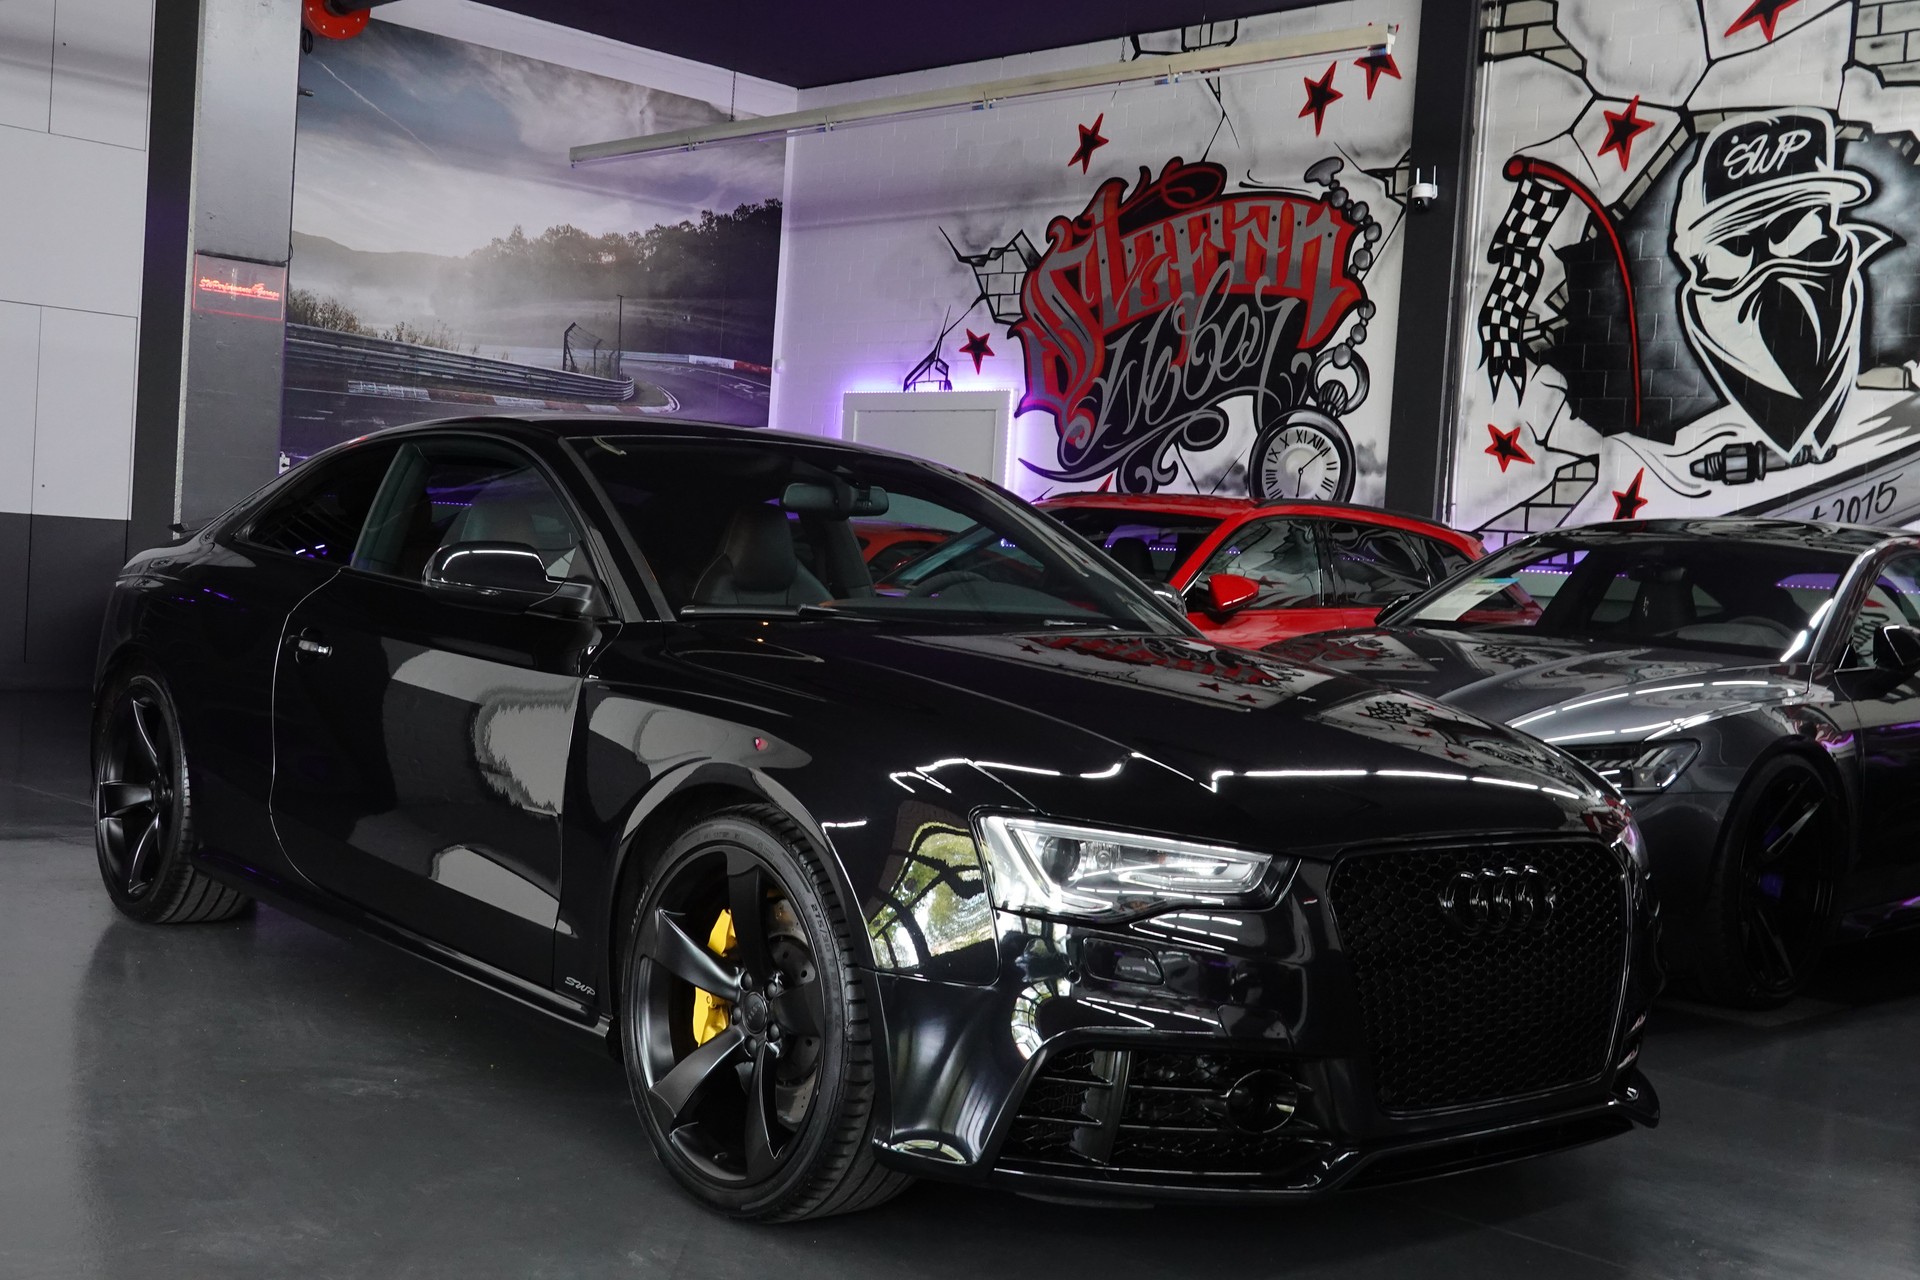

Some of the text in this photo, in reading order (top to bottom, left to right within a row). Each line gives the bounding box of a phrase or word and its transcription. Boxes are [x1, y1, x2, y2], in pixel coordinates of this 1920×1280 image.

[1723, 129, 1812, 180] SWP
[1074, 260, 1300, 442] Weber
[1832, 472, 1904, 523] 2015
[564, 976, 596, 996] SWP
